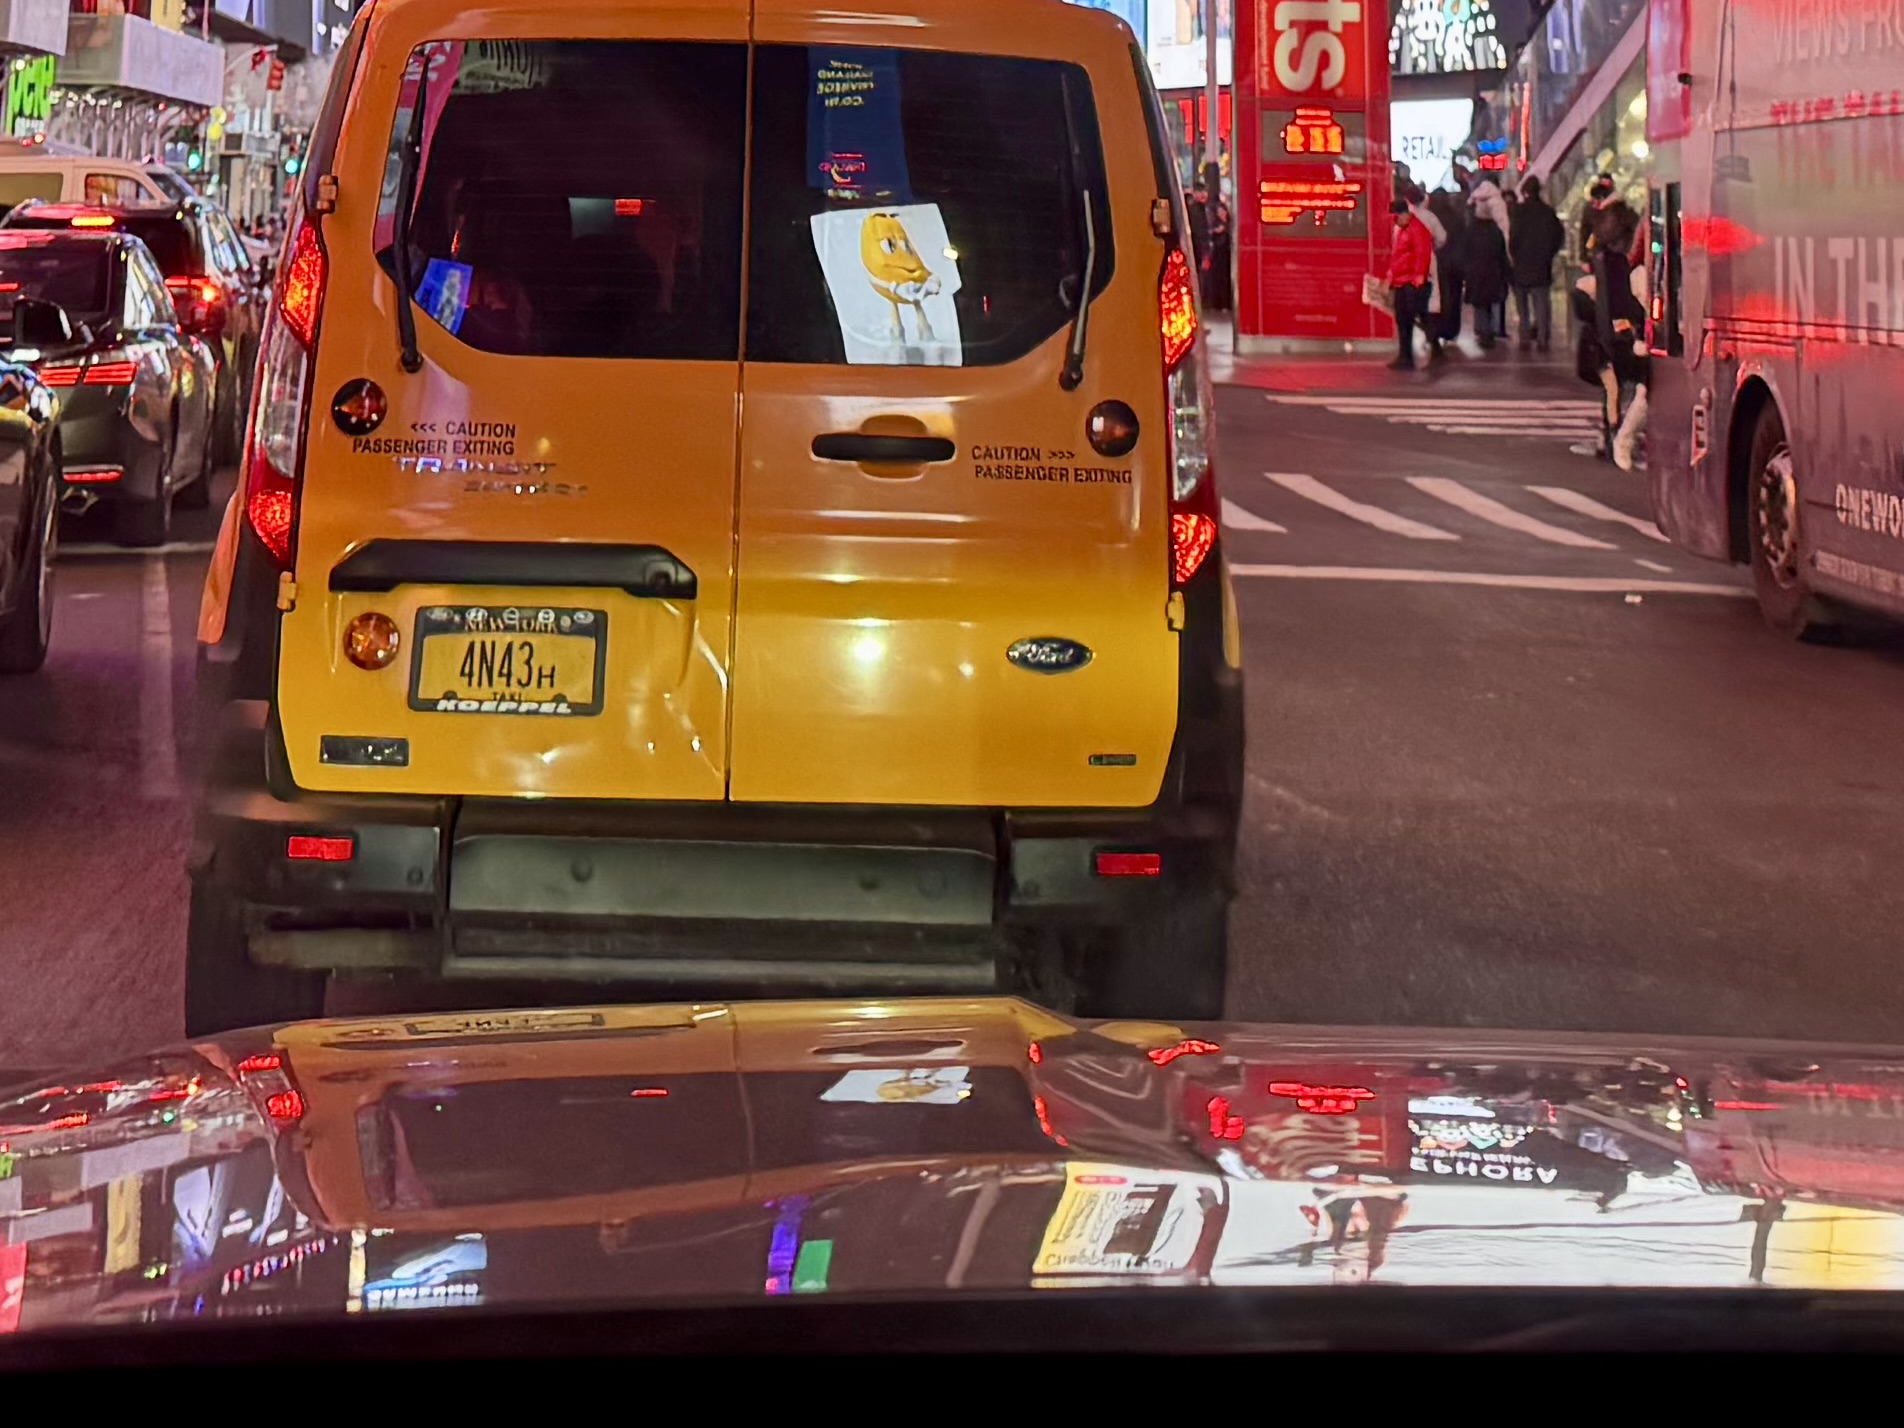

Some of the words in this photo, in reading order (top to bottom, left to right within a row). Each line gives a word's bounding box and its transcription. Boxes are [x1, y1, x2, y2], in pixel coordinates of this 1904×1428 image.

[1773, 235, 1817, 344] IN
[446, 420, 517, 438] CAUTION
[352, 437, 447, 455] PASSENGER
[452, 439, 516, 456] EXITING
[971, 445, 1041, 462] CAUTION
[974, 464, 1070, 483] PASSENGER
[1073, 467, 1133, 485] EXITING
[459, 640, 557, 689] 4N43H
[436, 699, 572, 715] KOEPPEL
